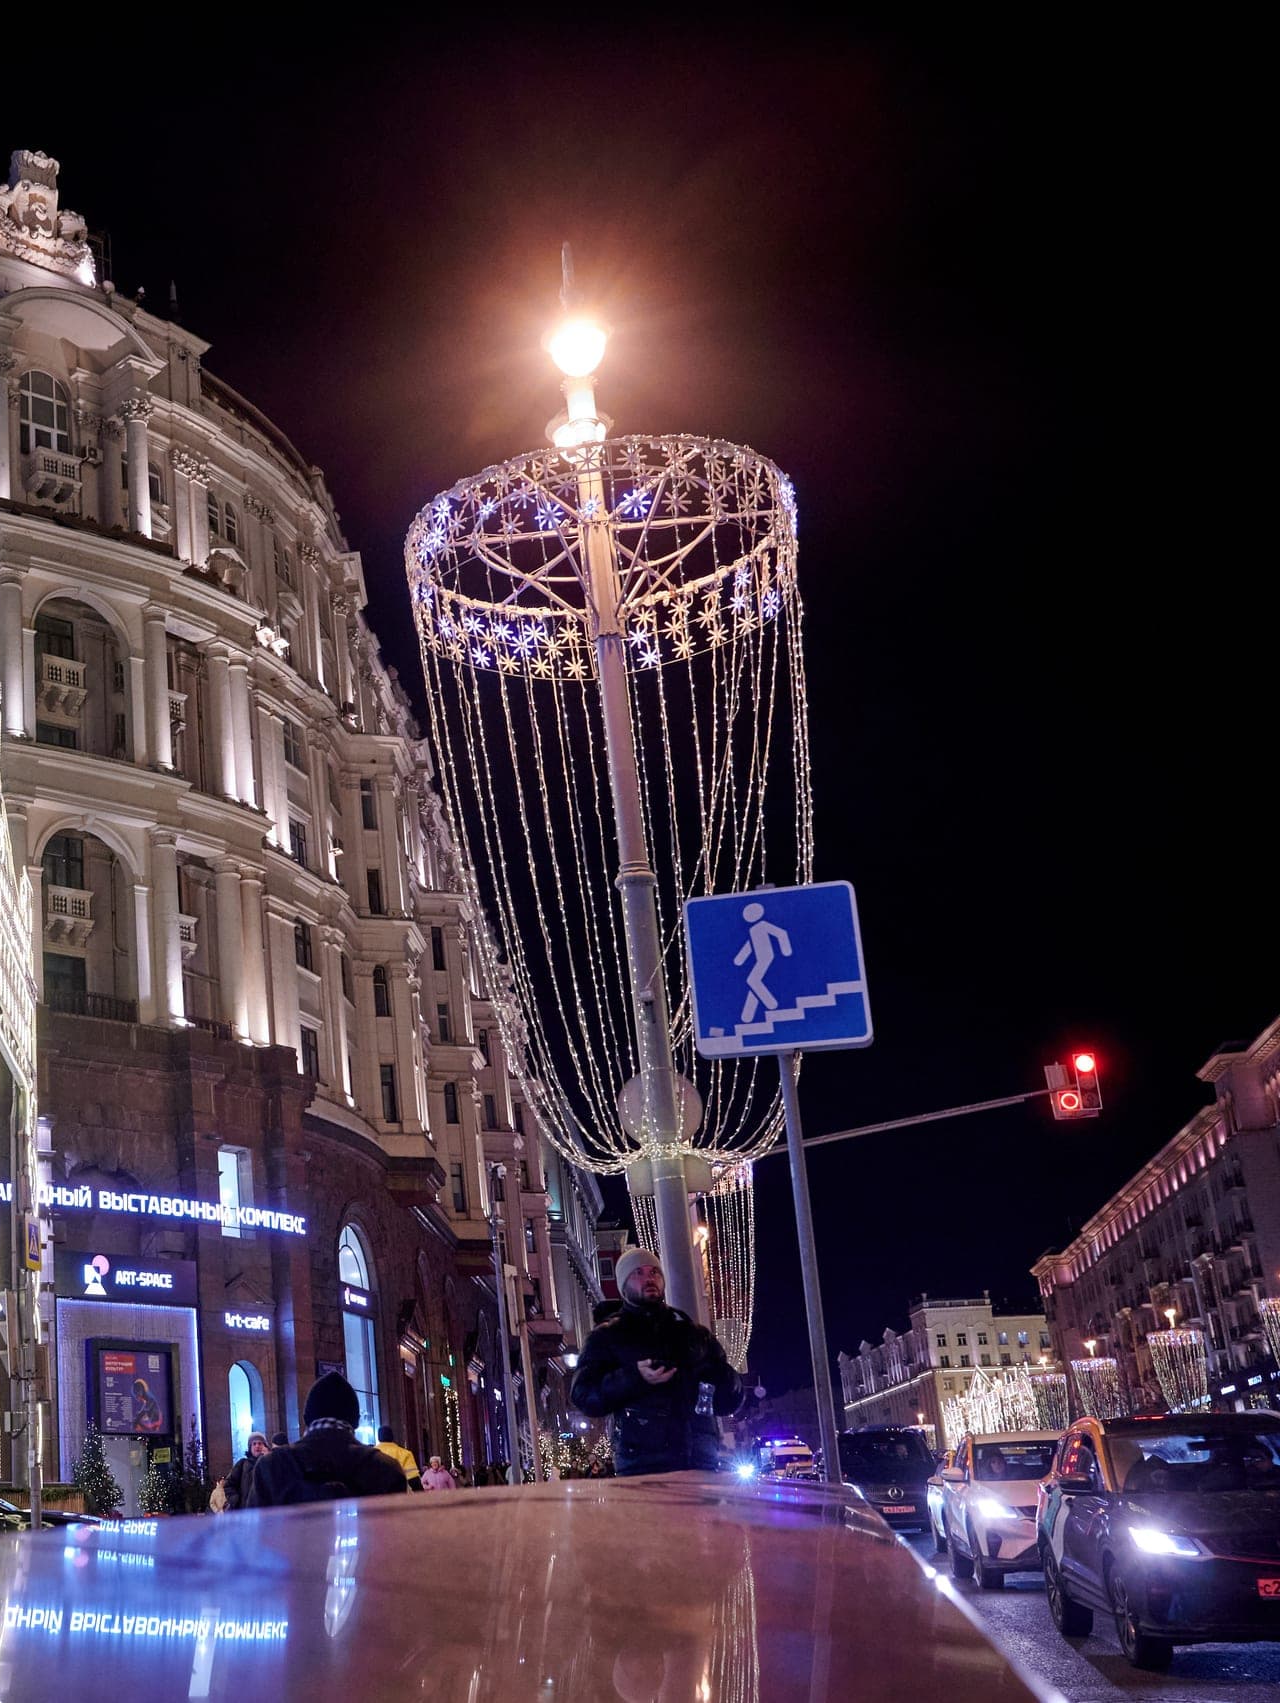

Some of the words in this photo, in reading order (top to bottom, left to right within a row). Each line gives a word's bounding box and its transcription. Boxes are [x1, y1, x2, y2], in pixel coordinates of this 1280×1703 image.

[98, 1190, 232, 1226] ВЫСТАВОЧНЫЙ
[236, 1206, 306, 1235] КОМПЛЕКС
[115, 1270, 173, 1288] ART-SPACE
[225, 1312, 270, 1331] Art-cafe
